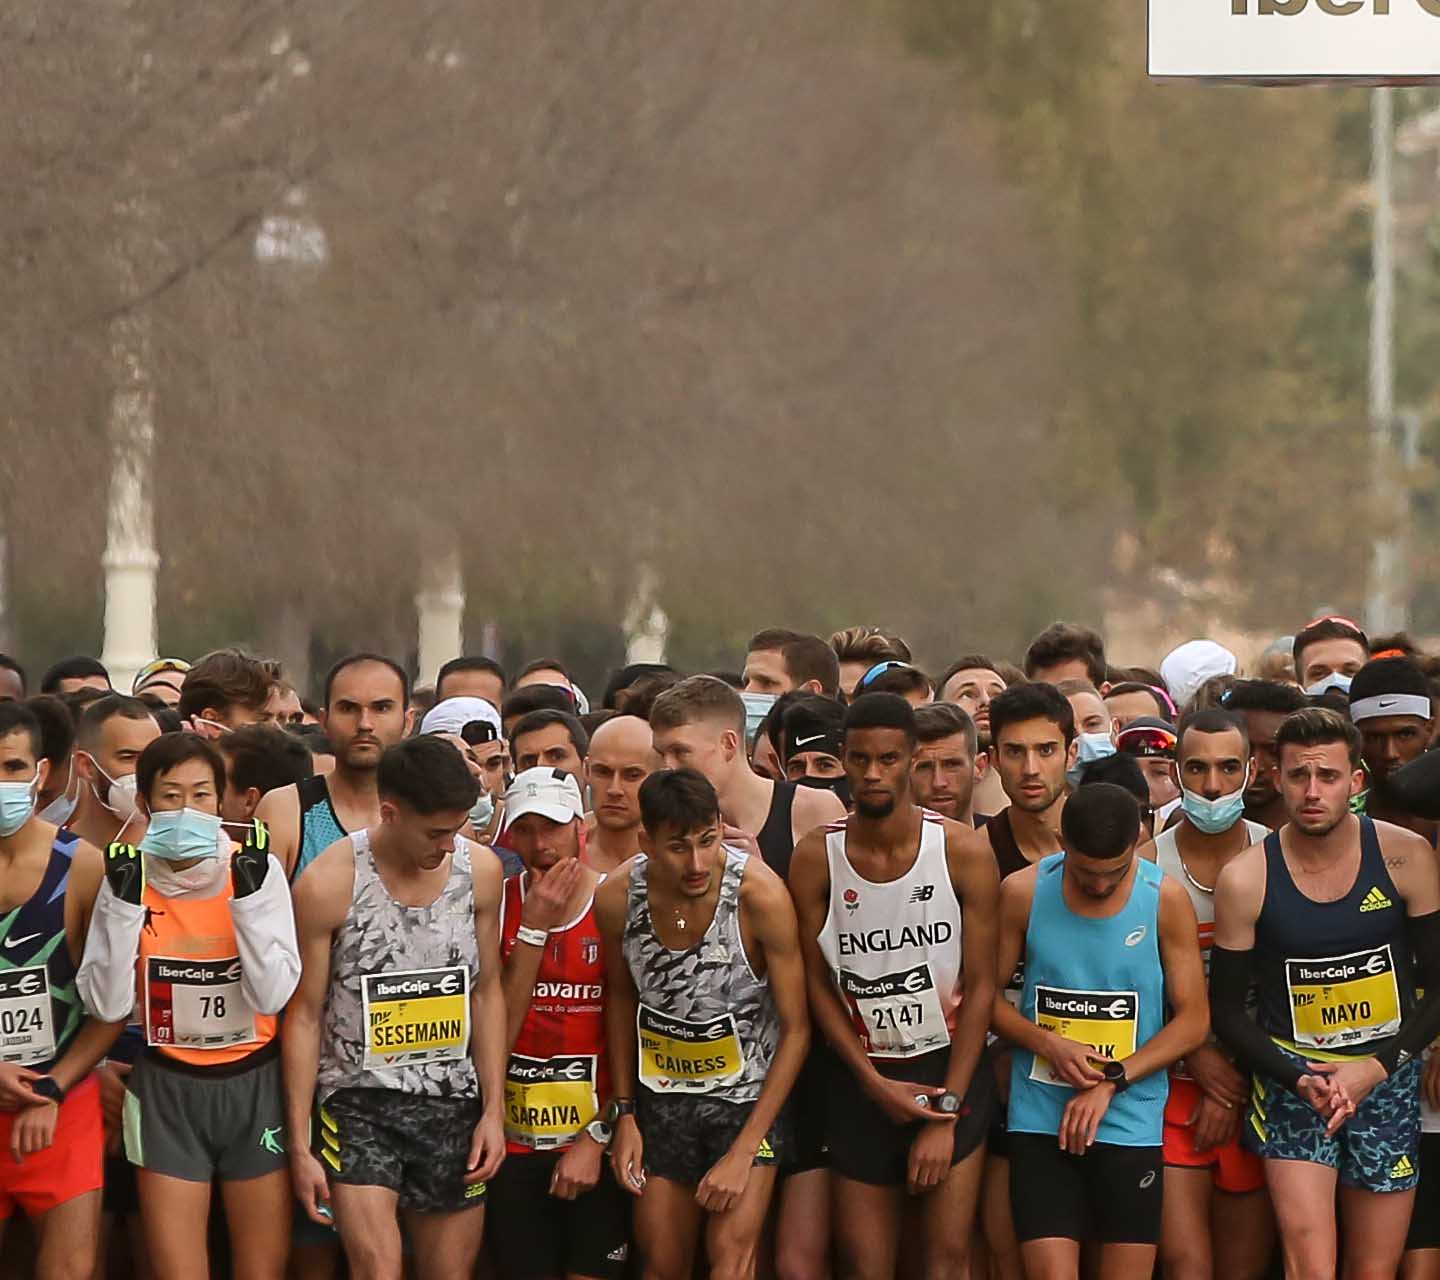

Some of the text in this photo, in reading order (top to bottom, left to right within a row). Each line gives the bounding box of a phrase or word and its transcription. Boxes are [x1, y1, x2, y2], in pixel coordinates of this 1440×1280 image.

[1360, 900, 1393, 913] adidas
[839, 921, 952, 956] ENGLAND
[158, 965, 215, 982] iberCaja
[1300, 965, 1356, 980] iberCaja
[377, 979, 431, 996] iberCaja
[847, 979, 895, 996] iberCaja
[199, 996, 227, 1019] 78
[871, 1003, 924, 1031] 2147
[1045, 997, 1098, 1016] iberCaja
[1321, 1001, 1372, 1026] MAYO
[374, 1019, 461, 1047] SESEMANN
[647, 1016, 695, 1038] iberCaja
[655, 1054, 727, 1075] CAIRESS
[511, 1106, 580, 1128] SARAIVA
